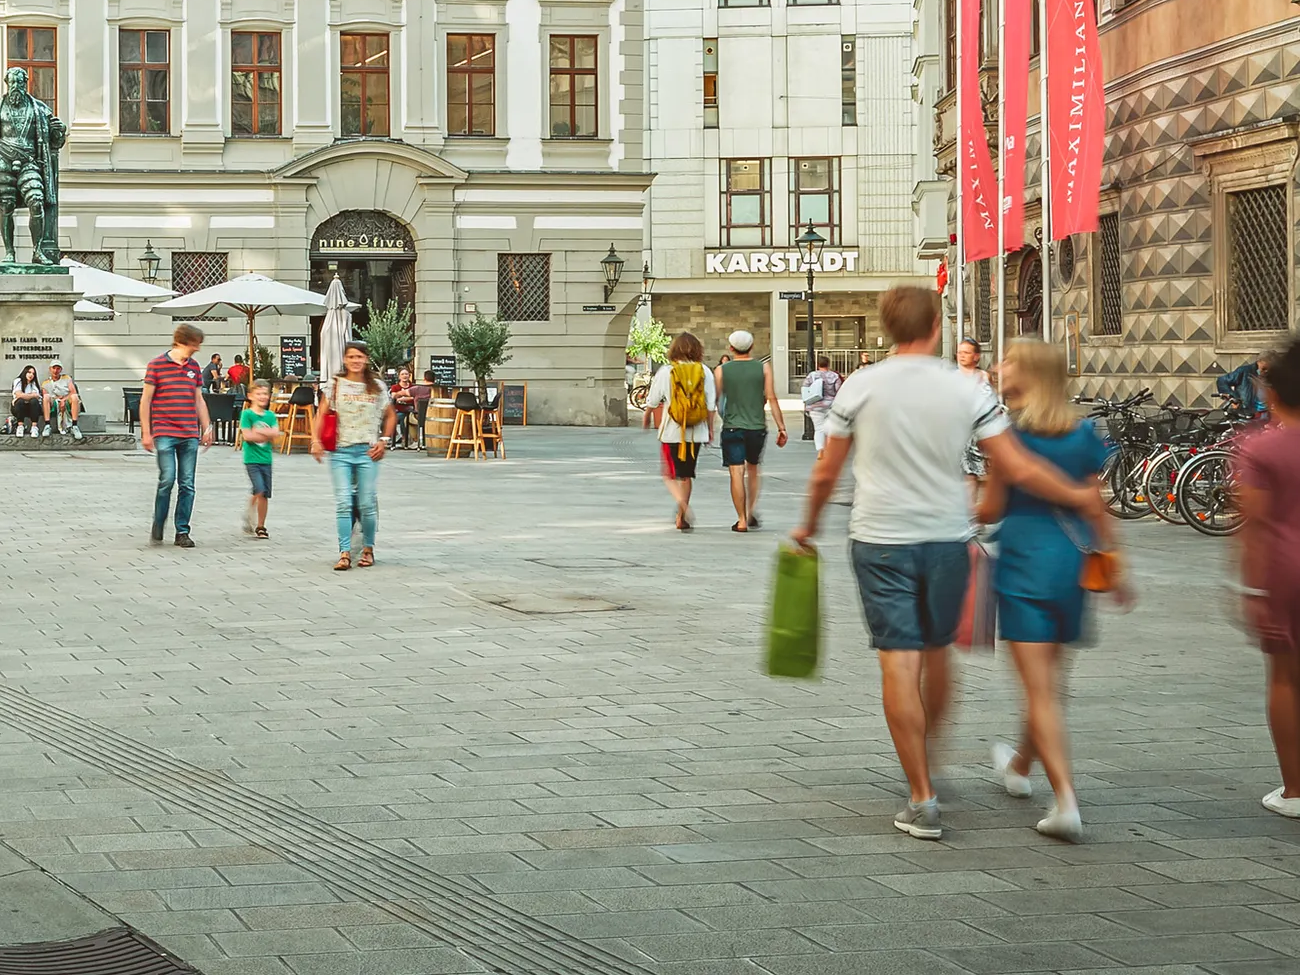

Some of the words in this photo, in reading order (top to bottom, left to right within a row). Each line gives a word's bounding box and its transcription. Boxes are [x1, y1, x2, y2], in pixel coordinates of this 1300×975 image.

[319, 238, 355, 248] nine
[372, 237, 404, 248] five
[705, 251, 860, 274] KARSTADT
